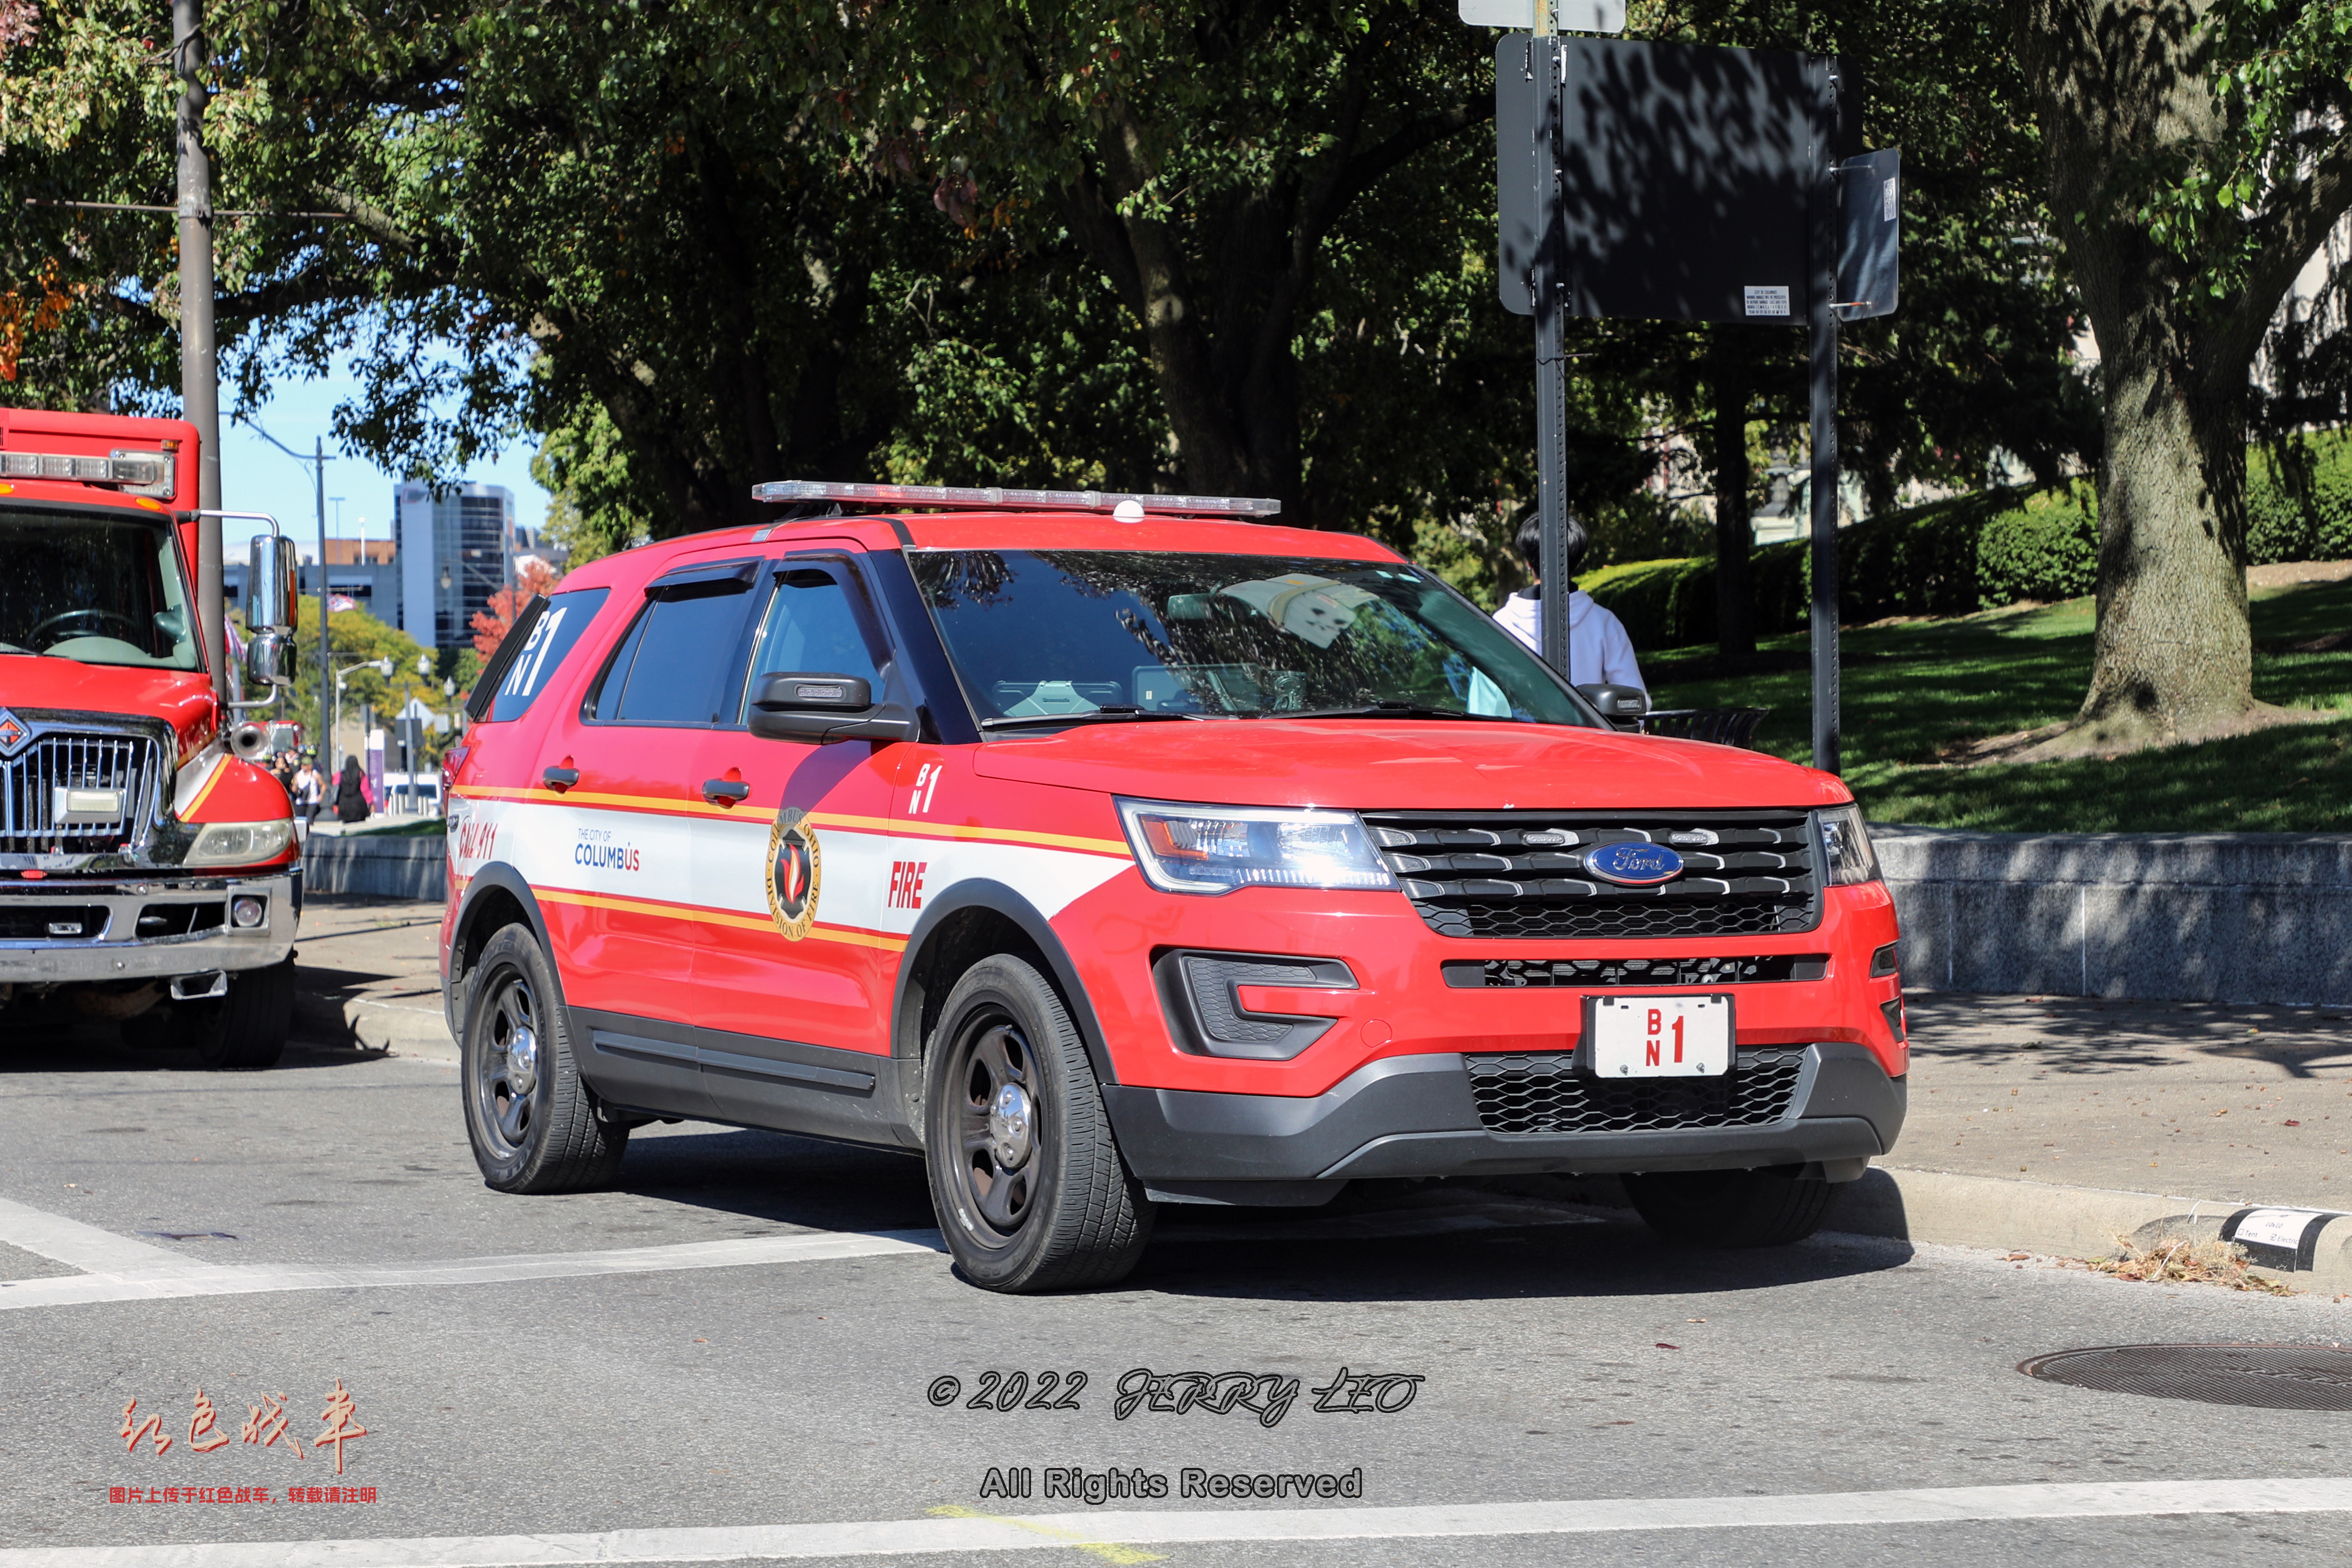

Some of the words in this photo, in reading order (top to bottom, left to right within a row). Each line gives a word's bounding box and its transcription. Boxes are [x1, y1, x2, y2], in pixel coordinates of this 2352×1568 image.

[477, 822, 498, 860] 911
[578, 828, 588, 840] THE
[589, 829, 602, 841] CITY
[603, 830, 612, 842] OF
[768, 809, 803, 863] COLUMBUS
[803, 823, 820, 868] OHIO
[575, 843, 639, 872] COLUMBUS
[1613, 847, 1665, 870] Ford
[888, 861, 927, 909] FIRE
[766, 877, 793, 938] DIVISION
[796, 920, 806, 937] OF
[807, 881, 819, 922] FIRE
[2278, 1236, 2298, 1245] Electric
